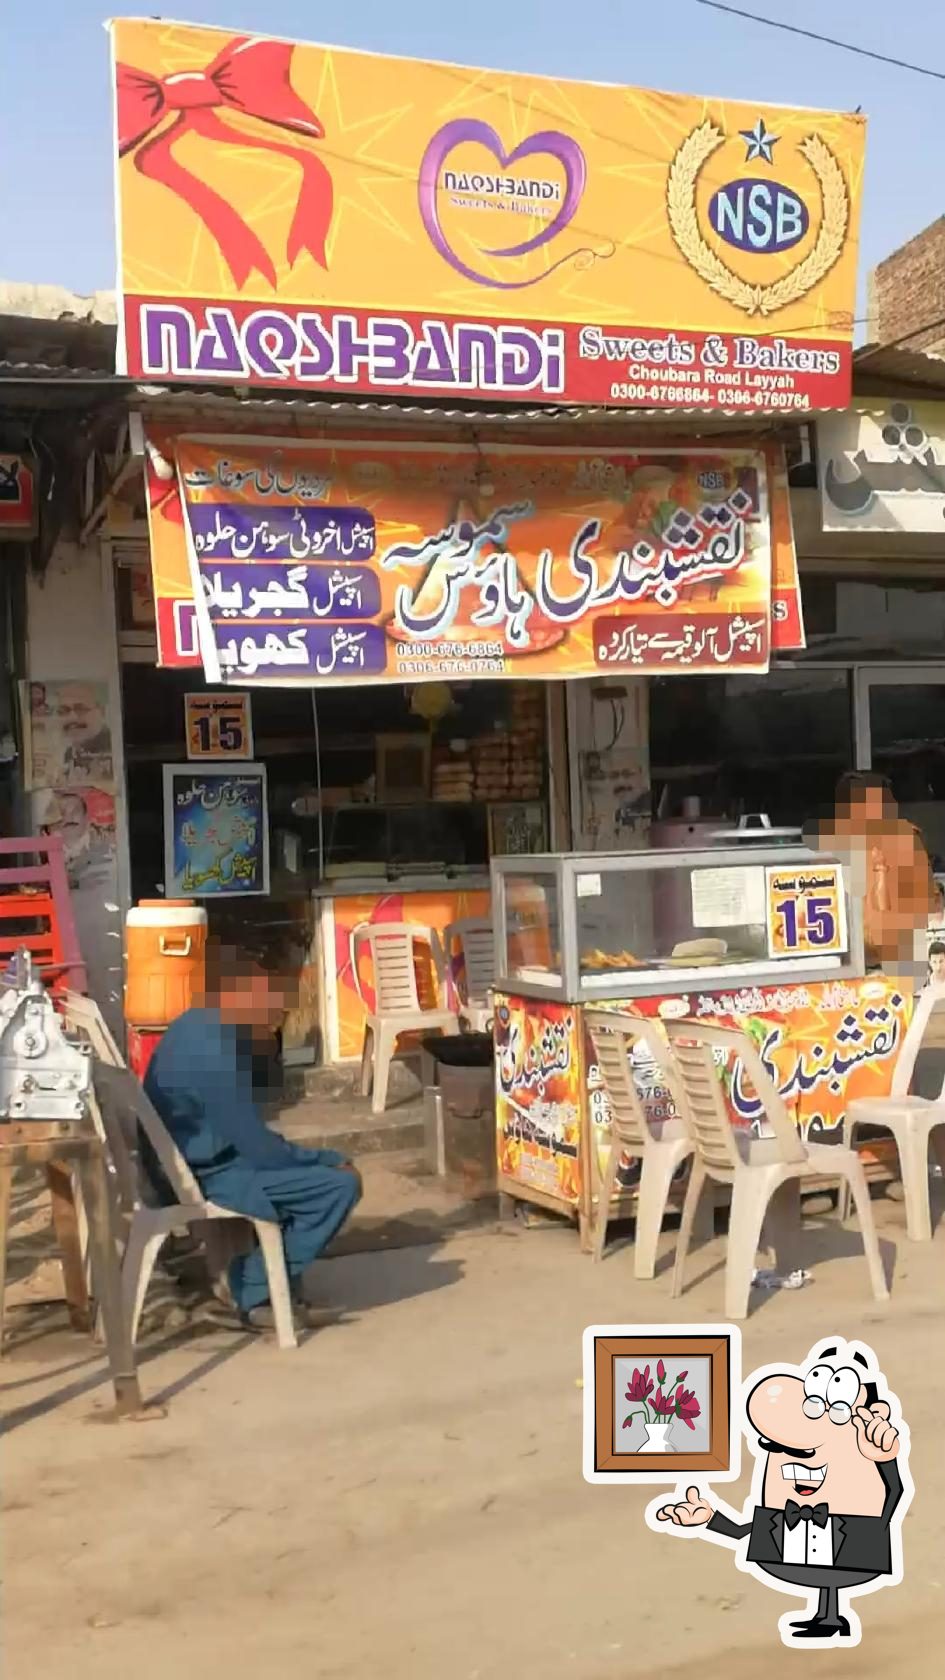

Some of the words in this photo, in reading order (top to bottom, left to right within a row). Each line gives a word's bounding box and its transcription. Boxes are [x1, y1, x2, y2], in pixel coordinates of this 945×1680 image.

[715, 187, 804, 246] NSB
[579, 326, 695, 364] Sweets
[700, 335, 728, 367] &
[733, 337, 841, 374] Bakers
[628, 364, 701, 383] Choubara
[704, 368, 741, 385] Road
[745, 373, 795, 390] Layyah
[195, 510, 238, 552] حلوہ
[380, 500, 536, 572] سموسہ
[536, 488, 753, 623] نقشبندی
[312, 569, 363, 617] اسپیشل
[315, 626, 368, 675] اسپیشل
[691, 626, 719, 659] آلو
[714, 615, 766, 663] اسپیشل
[192, 715, 243, 751] 15
[776, 896, 836, 948] 15
